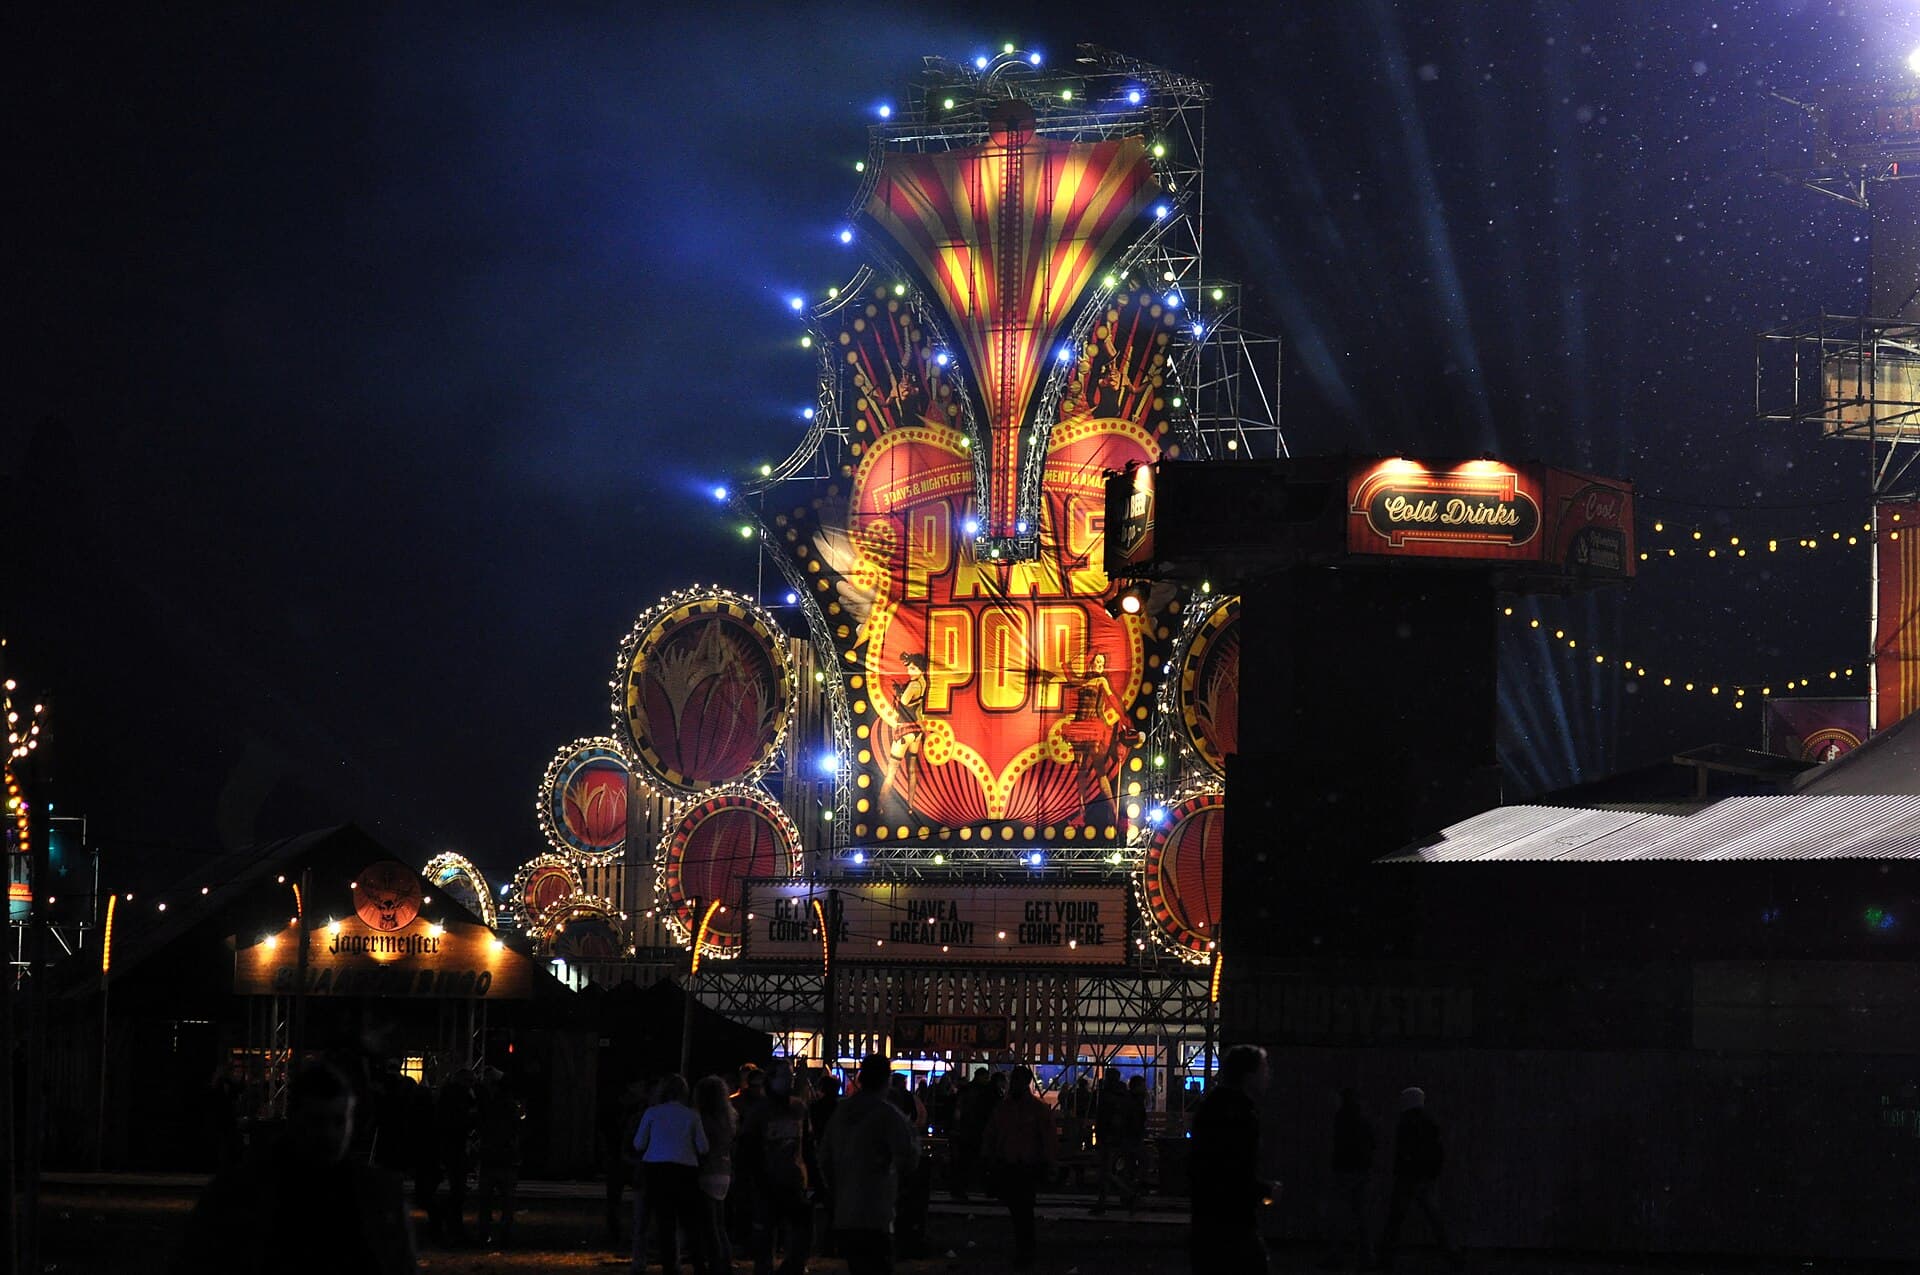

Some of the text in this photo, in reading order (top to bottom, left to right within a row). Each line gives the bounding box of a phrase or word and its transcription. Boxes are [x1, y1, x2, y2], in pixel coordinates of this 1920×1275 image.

[890, 486, 913, 503] DAYS
[912, 483, 921, 495] &
[921, 475, 950, 494] NIGHTS
[1071, 471, 1080, 486] &
[1384, 496, 1521, 526] Cold Drinks
[925, 605, 1090, 712] POP
[908, 900, 959, 921] HAVE A
[1025, 901, 1099, 922] GET YOUR
[768, 921, 809, 942] COINS
[890, 922, 974, 945] GREAT DAY!
[1018, 923, 1105, 945] COINS HERE
